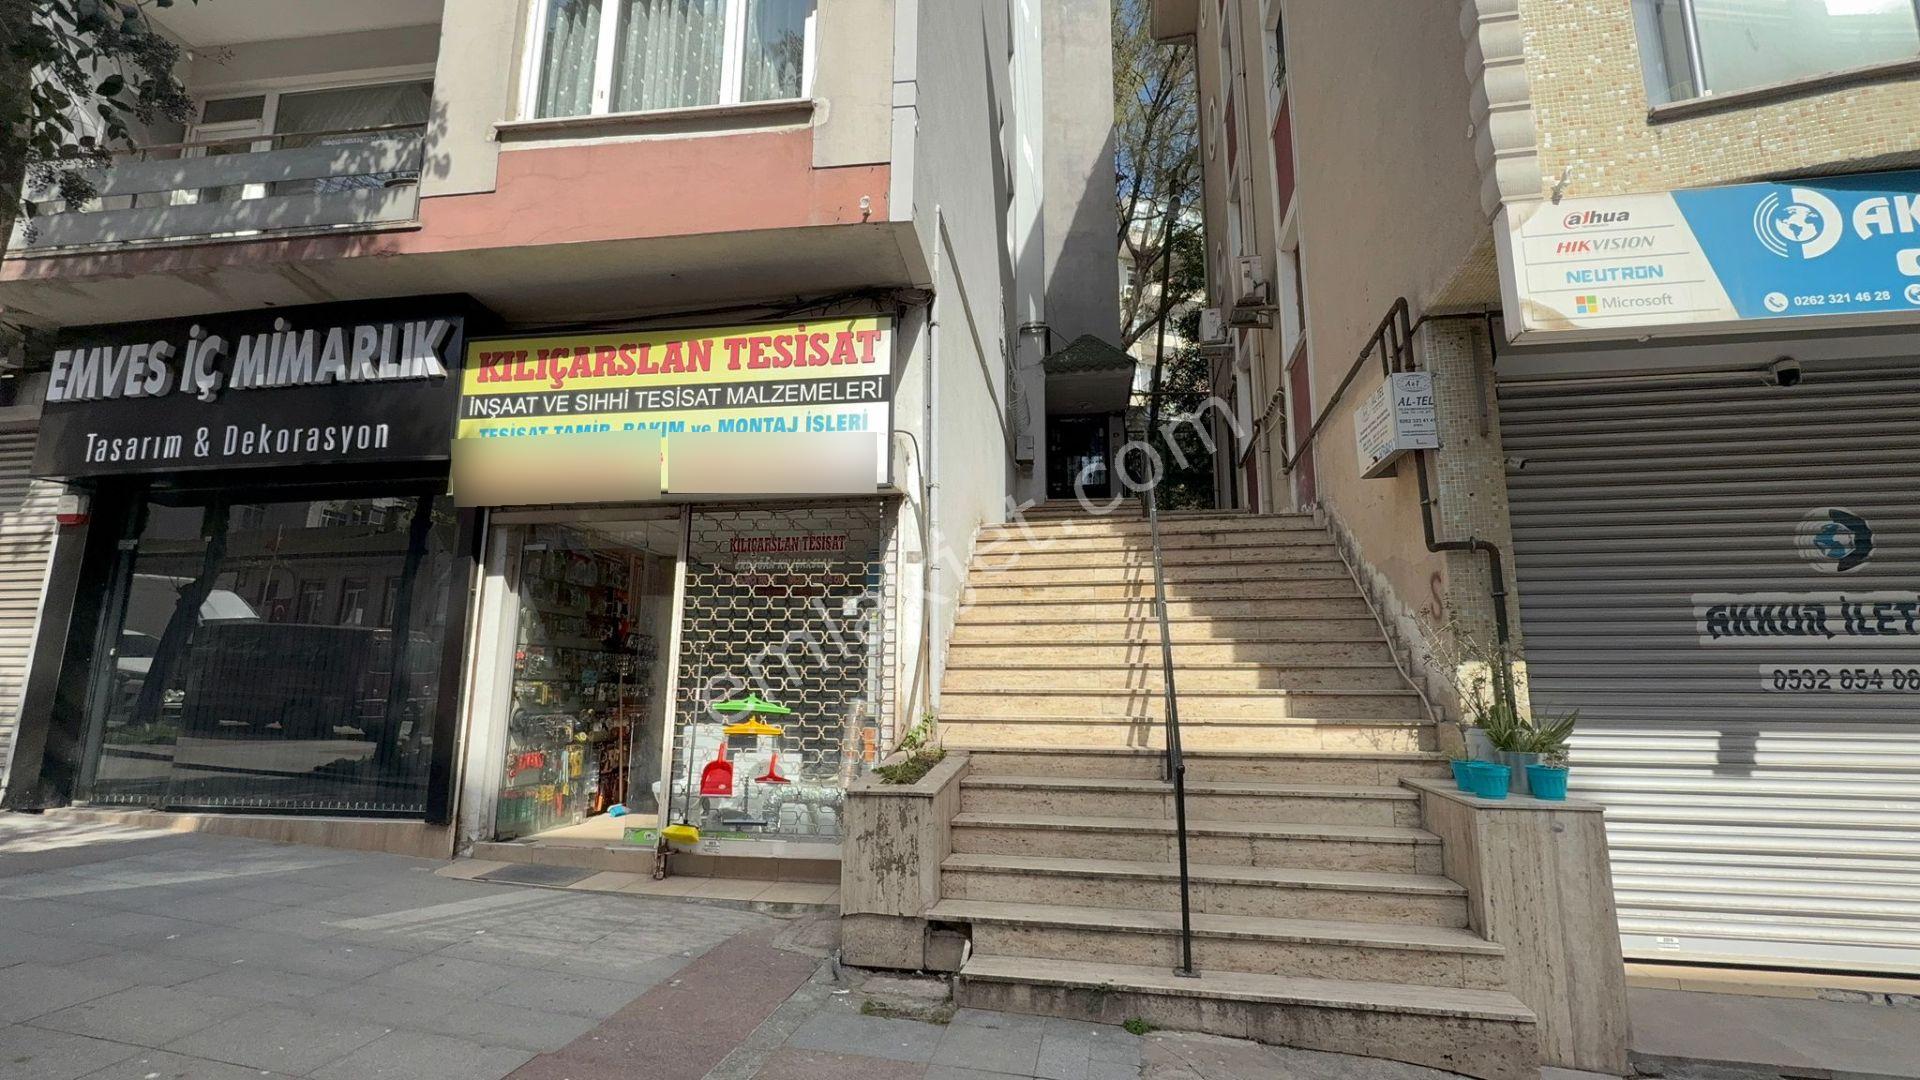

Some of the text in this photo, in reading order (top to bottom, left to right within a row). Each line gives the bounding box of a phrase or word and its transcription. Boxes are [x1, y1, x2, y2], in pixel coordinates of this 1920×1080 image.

[1556, 235, 1655, 254] HIKVISION
[1566, 264, 1664, 283] NEUTRON
[1602, 292, 1673, 309] Microsoft
[1794, 296, 1825, 306] 0262
[1828, 293, 1850, 304] 321
[1874, 290, 1891, 301] 28
[46, 317, 450, 401] EMVES İÇ MİMARLIK
[477, 325, 881, 389] KILIÇARSLAN TESİSAT
[469, 376, 884, 419] İNŞAAT VE SIHHİ TESİSAT MALZEMELERİ
[717, 416, 799, 432] MONTAJ
[86, 423, 390, 464] Tasarım & Dekorasyon
[1840, 595, 1920, 636] İLET
